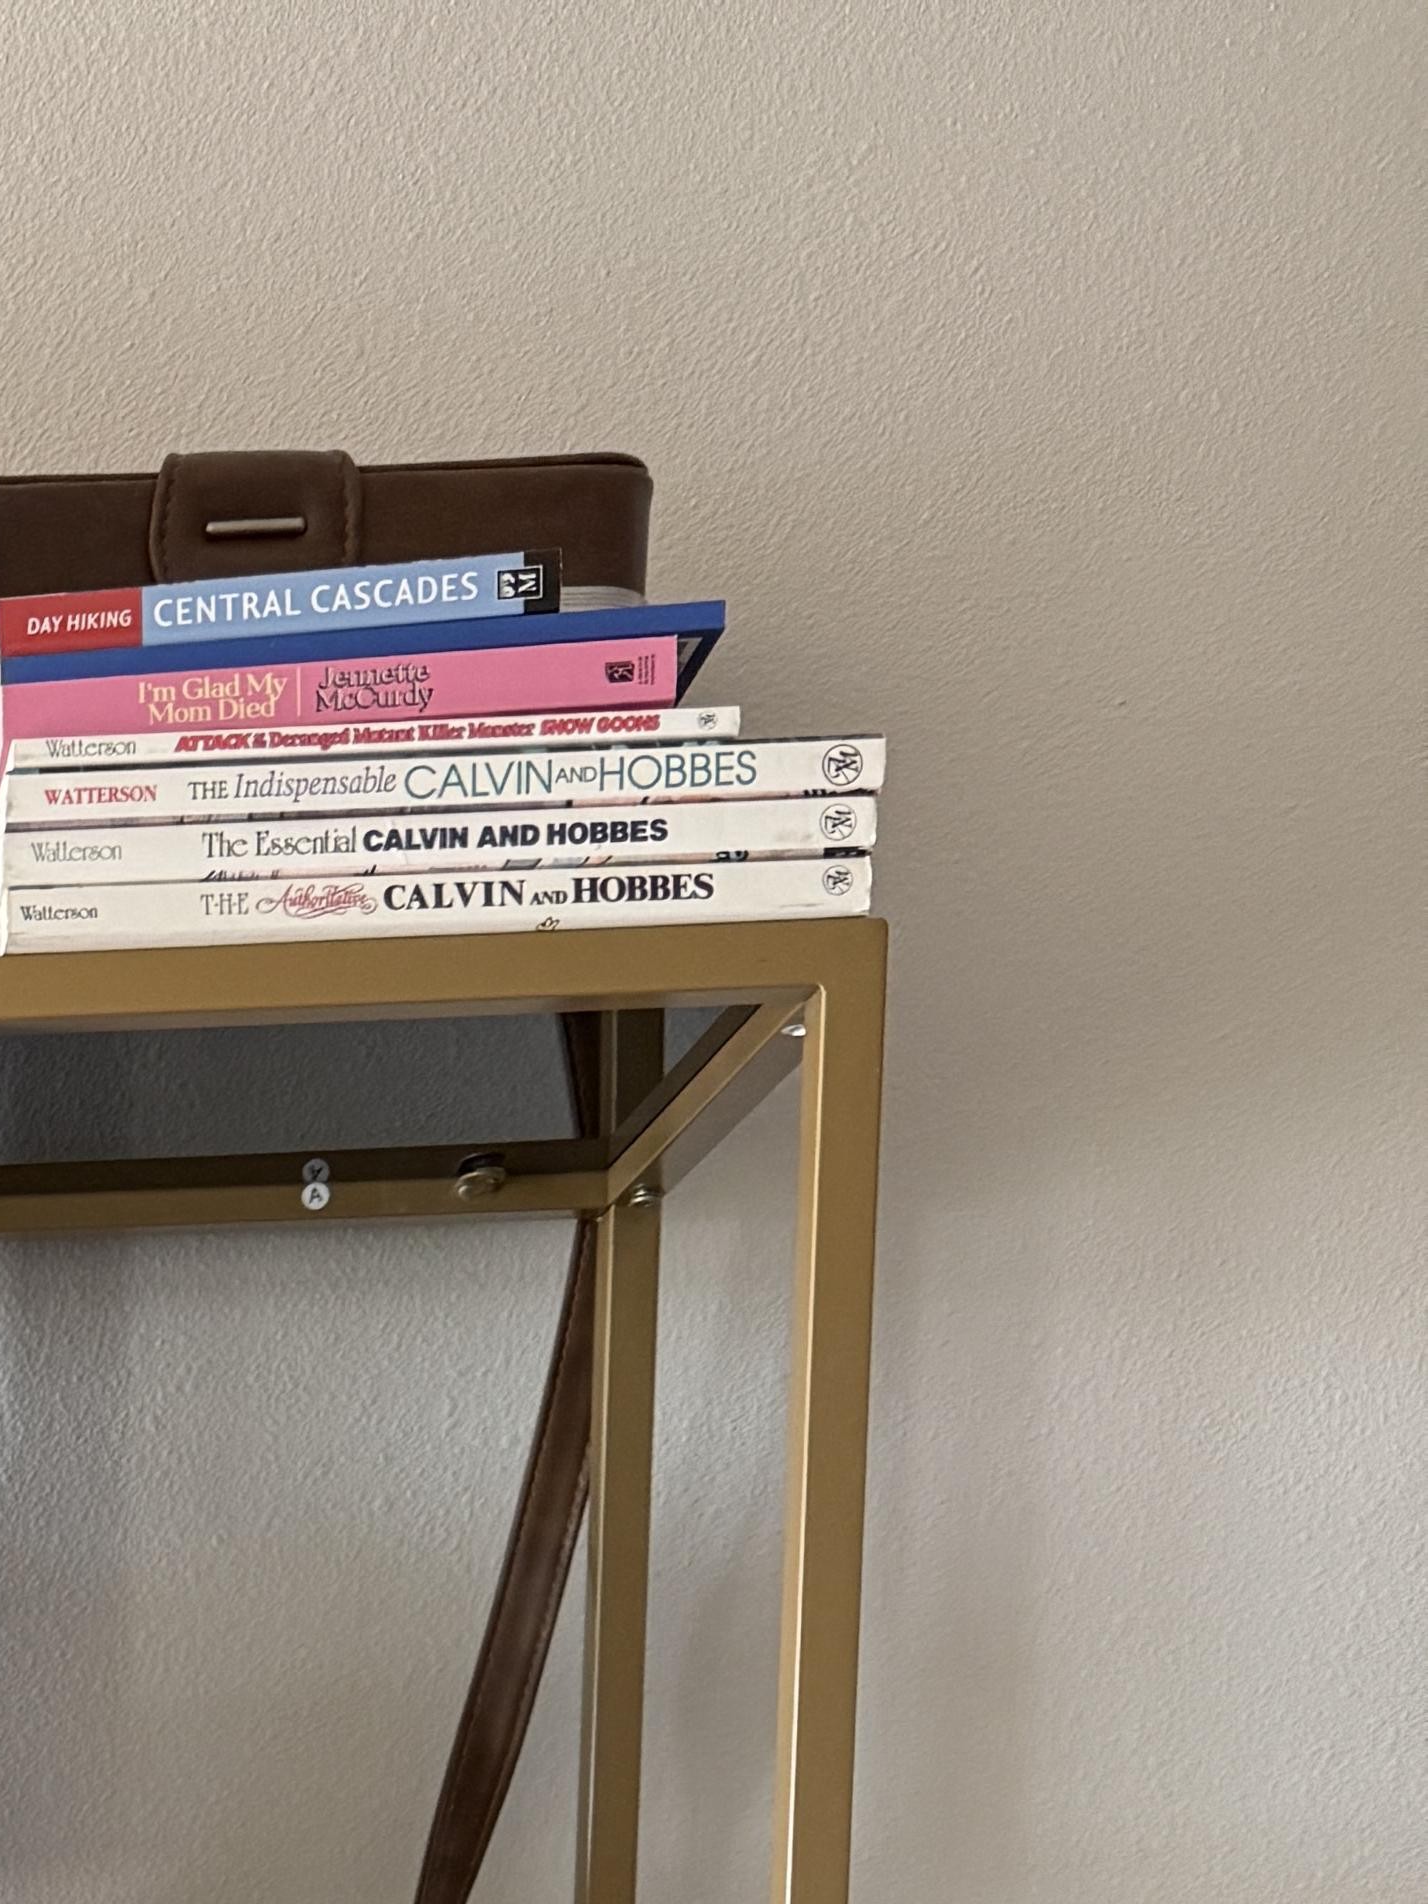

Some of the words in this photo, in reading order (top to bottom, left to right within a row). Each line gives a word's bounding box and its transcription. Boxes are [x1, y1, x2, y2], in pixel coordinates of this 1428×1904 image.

[154, 594, 301, 627] CENTRAL
[311, 572, 478, 611] CASCADES
[27, 614, 62, 636] DAY
[67, 609, 132, 632] HIKING
[139, 684, 174, 703] I'm
[182, 678, 240, 699] Glad
[247, 673, 288, 707] My
[149, 702, 214, 724] Mom
[219, 696, 275, 719] Died
[45, 785, 156, 805] WATTERSON
[188, 781, 228, 801] THE
[234, 766, 396, 803] Indispensable
[404, 760, 553, 800] CALVIN
[556, 765, 597, 784] AND
[599, 751, 757, 790] HOBBES
